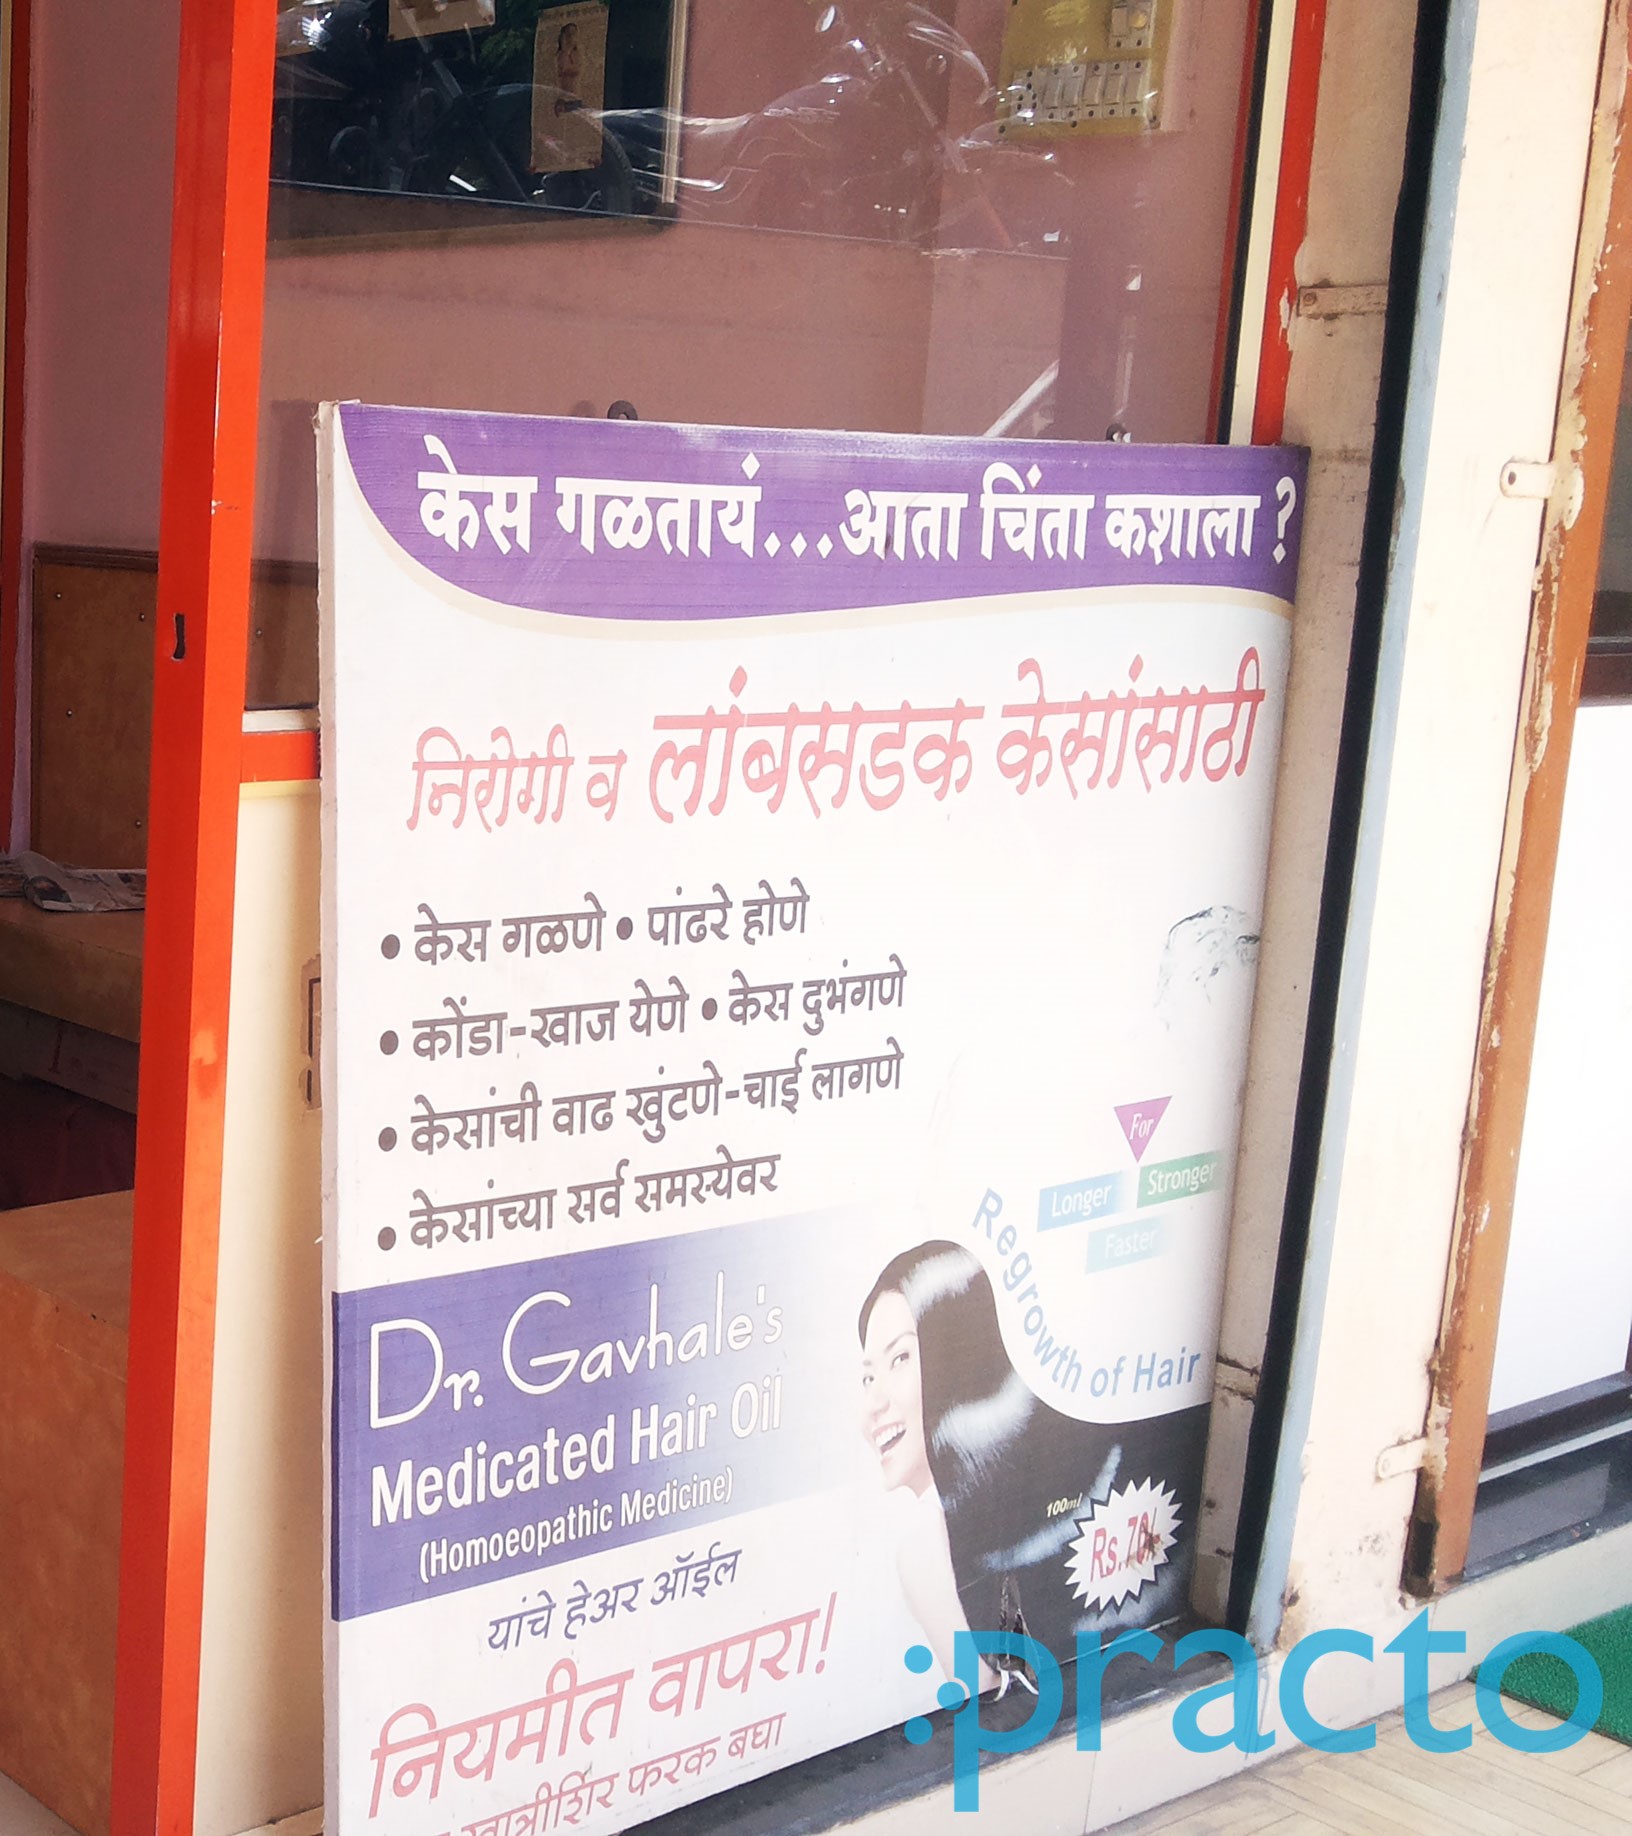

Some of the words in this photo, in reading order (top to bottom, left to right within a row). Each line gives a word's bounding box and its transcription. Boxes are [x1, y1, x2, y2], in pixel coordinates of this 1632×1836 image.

[417, 435, 538, 557] केस
[979, 462, 1091, 562] चिंता
[1105, 492, 1261, 568] कशाला
[1269, 475, 1297, 565] ?
[406, 722, 576, 833] निरोगी
[587, 748, 628, 822] व
[649, 665, 985, 825] लांबसडक
[996, 646, 1265, 800] केसांसाठी
[414, 903, 492, 966] केस
[501, 892, 606, 959] गळणे
[647, 883, 733, 949] पांढरे
[742, 877, 810, 946] होणे
[629, 975, 690, 1038] येणे
[727, 969, 794, 1027] केस
[802, 953, 908, 1036] दुभंगणे
[410, 1081, 542, 1156] केसांची
[552, 1089, 617, 1136] वाढ
[812, 1036, 905, 1101] लागणे
[1128, 1112, 1155, 1141] For
[409, 1178, 557, 1251] केसांच्या
[567, 1158, 630, 1224] सर्व
[635, 1144, 782, 1217] समस्येवर
[1050, 1182, 1113, 1218] Longer
[1147, 1159, 1218, 1197] Stronger
[1104, 1227, 1159, 1260] Faster
[971, 1187, 1083, 1394] Regrowth
[1089, 1355, 1127, 1398] of
[1132, 1346, 1201, 1394] Hair
[369, 1317, 484, 1431] Dr.
[501, 1270, 784, 1396] Gavhale's
[370, 1413, 616, 1528] Medicated
[630, 1392, 718, 1466] Hair
[730, 1374, 784, 1441] Oil
[1045, 1491, 1083, 1519] 100ml
[418, 1498, 614, 1584] (Homoeopathic
[619, 1466, 735, 1529] Medicine)
[487, 1590, 557, 1652] यांचे
[563, 1580, 644, 1641] हेअर
[649, 1540, 744, 1606] ऑईल
[368, 1657, 635, 1819] नियमीत
[648, 1591, 839, 1718] वापरा!
[627, 1734, 722, 1798] फरक
[727, 1711, 787, 1761] बघा
